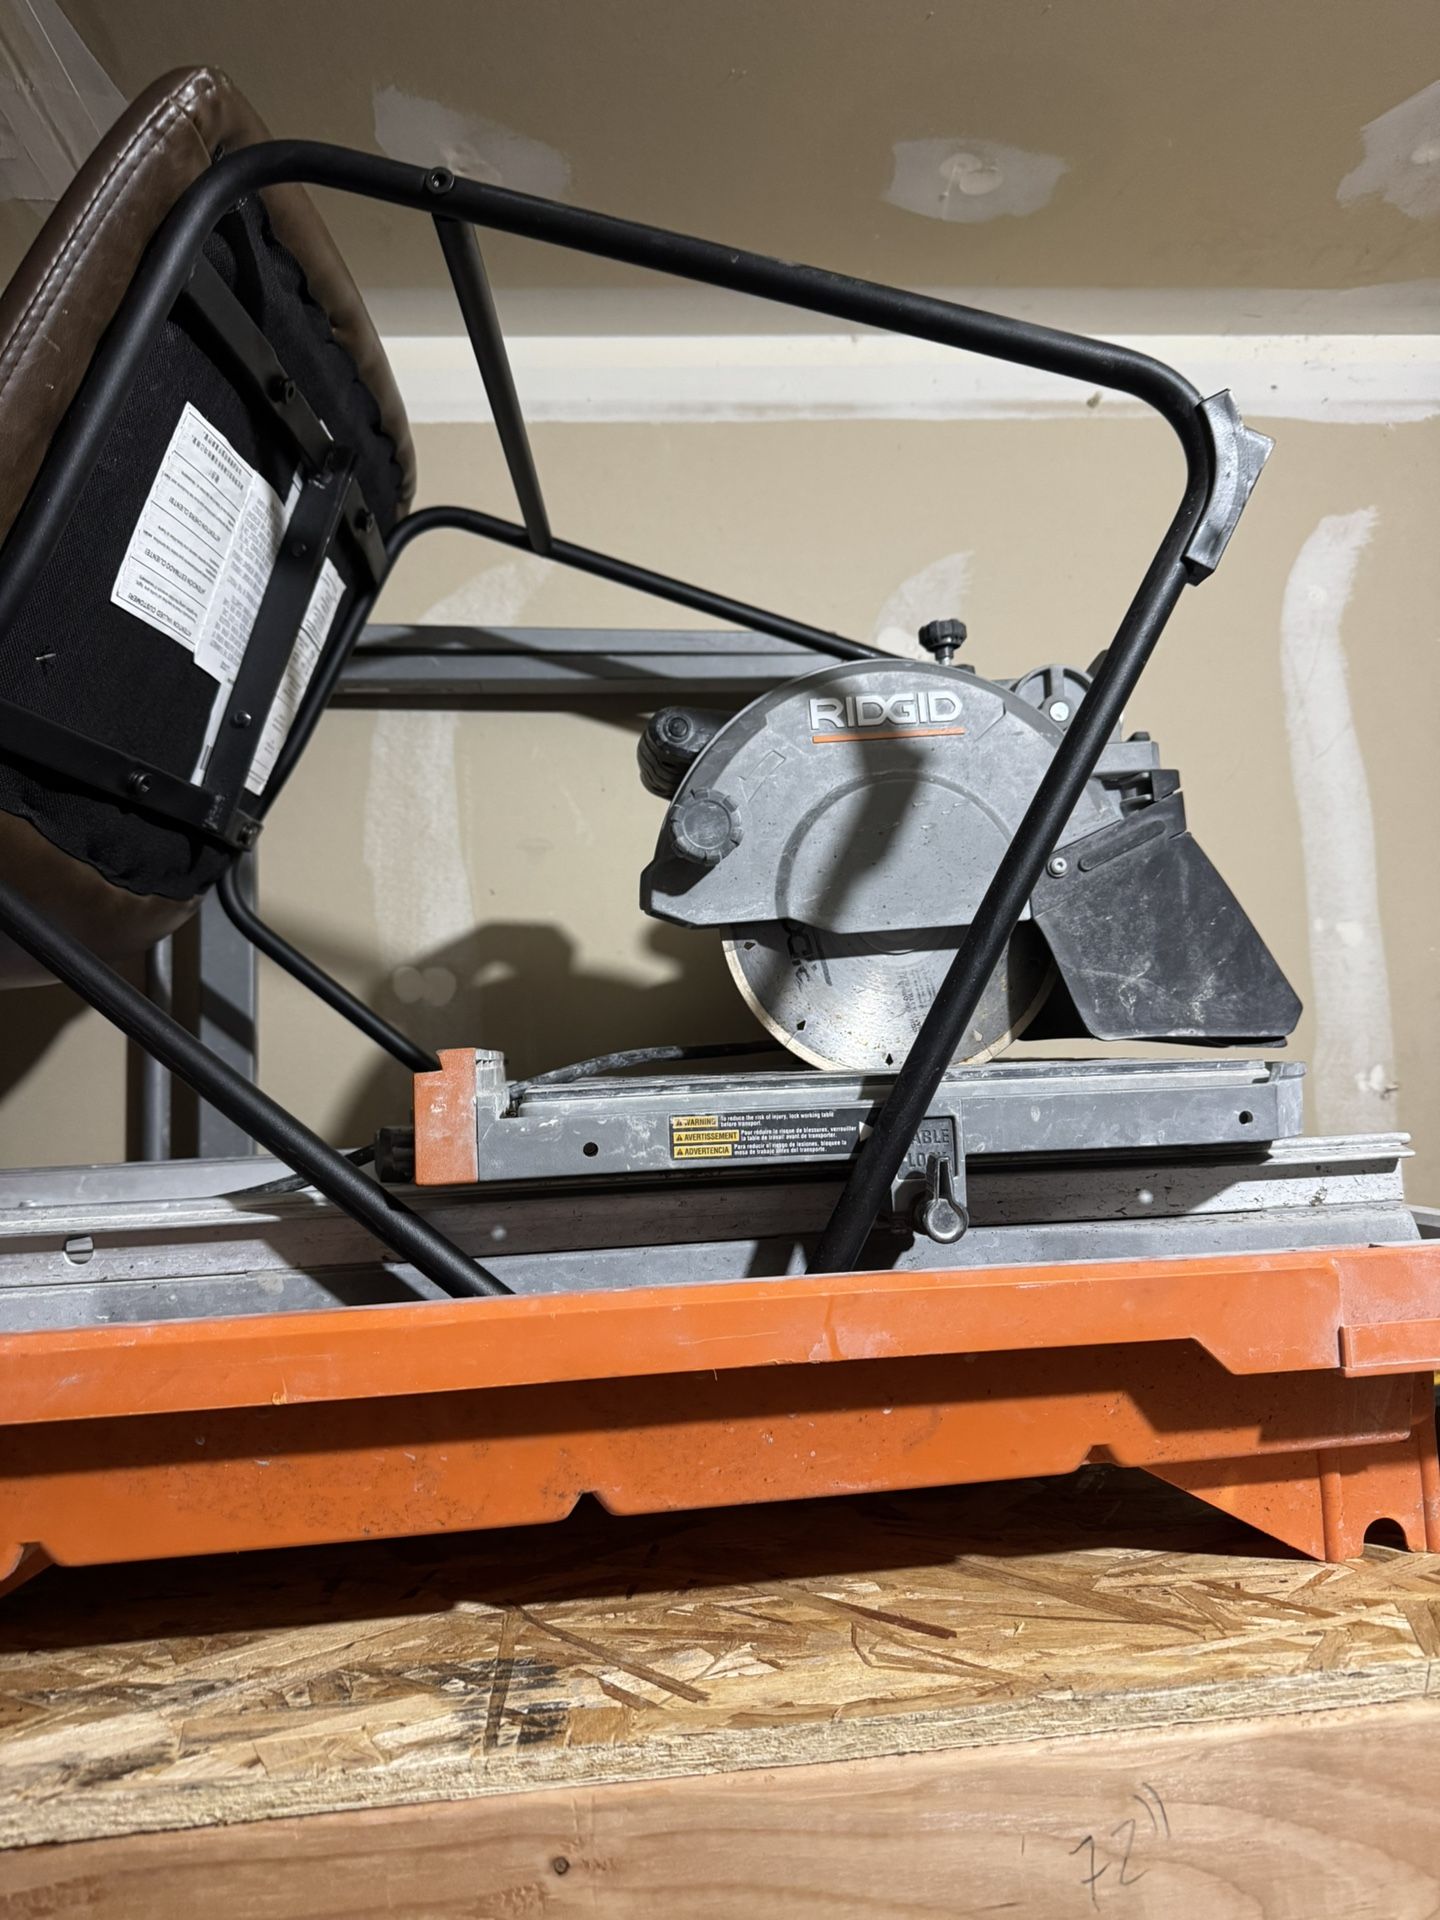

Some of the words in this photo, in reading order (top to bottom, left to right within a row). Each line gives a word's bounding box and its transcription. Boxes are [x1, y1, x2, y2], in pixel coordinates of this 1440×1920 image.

[809, 690, 963, 730] RIDGID
[684, 1118, 716, 1126] WARNING
[684, 1131, 737, 1140] AVERTISSEMENT
[912, 1129, 950, 1144] ABLE
[685, 1146, 730, 1155] ADVERTENCIA
